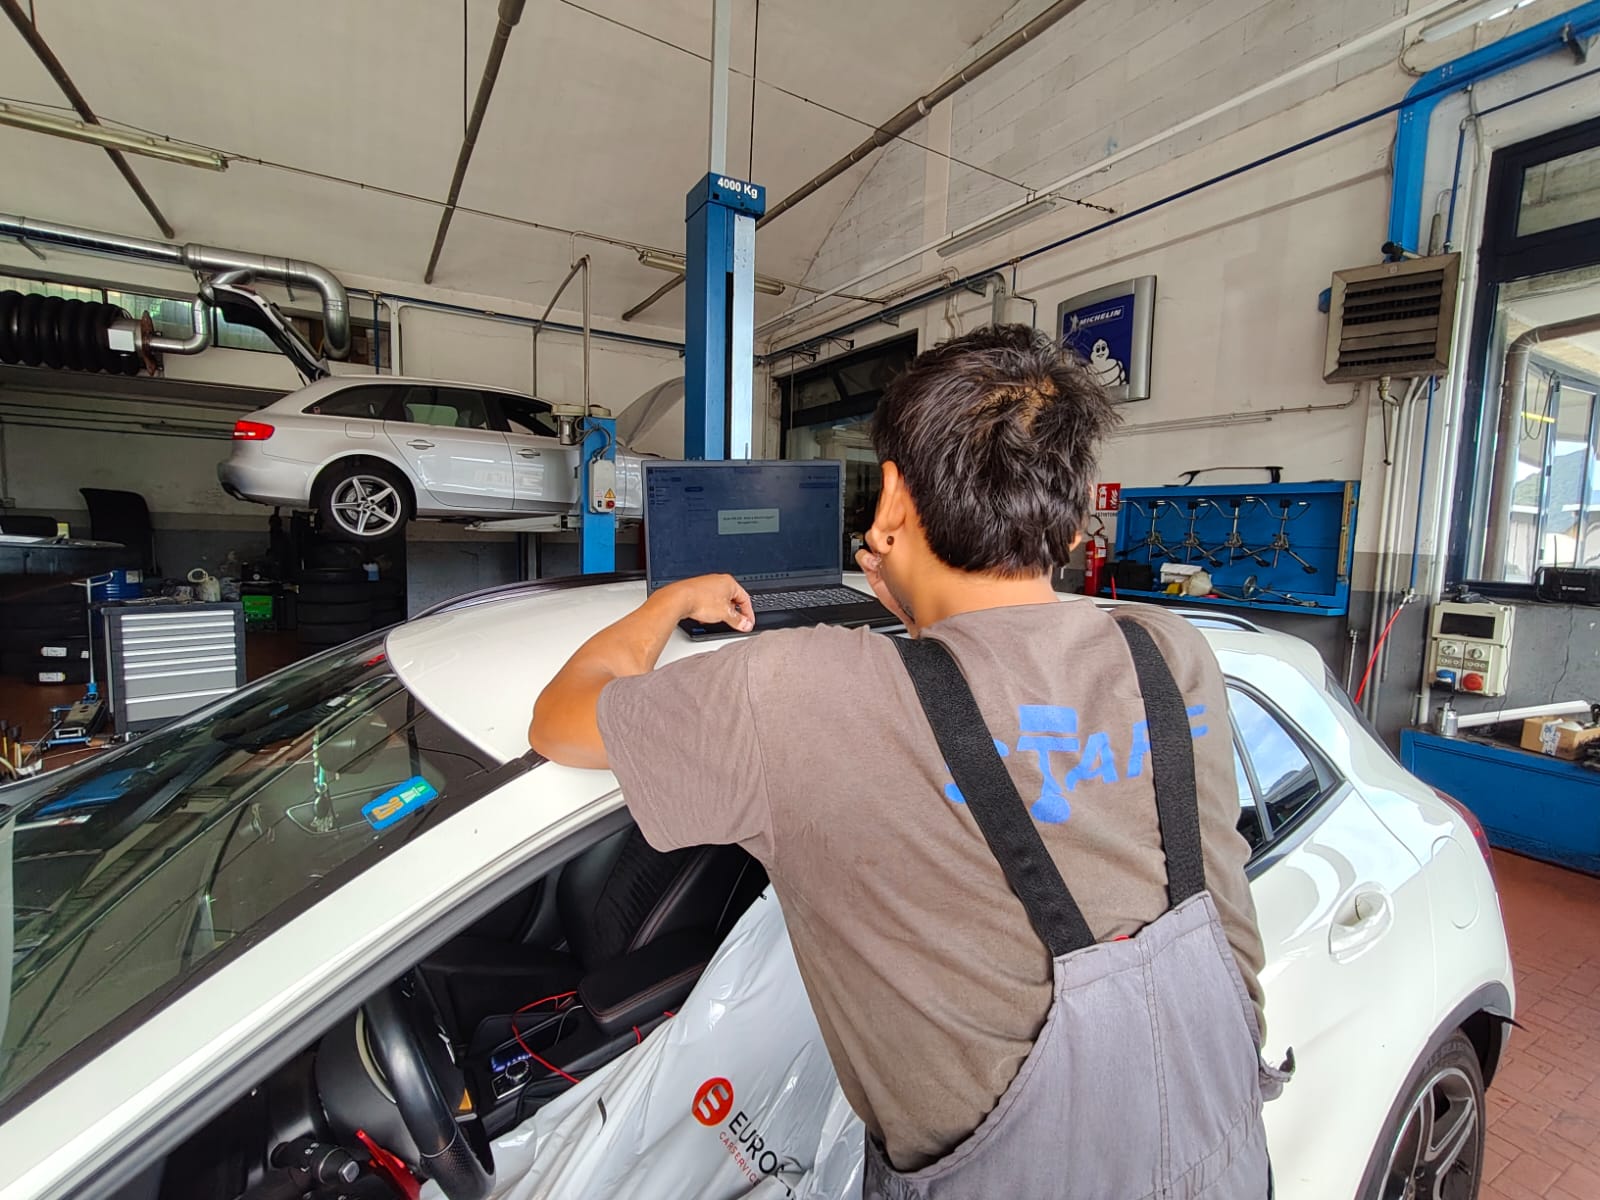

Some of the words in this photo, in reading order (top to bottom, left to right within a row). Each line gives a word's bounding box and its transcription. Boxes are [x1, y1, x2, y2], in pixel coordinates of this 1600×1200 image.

[717, 177, 741, 192] 4000
[744, 184, 758, 199] Kg
[1079, 308, 1122, 325] MICHELIN
